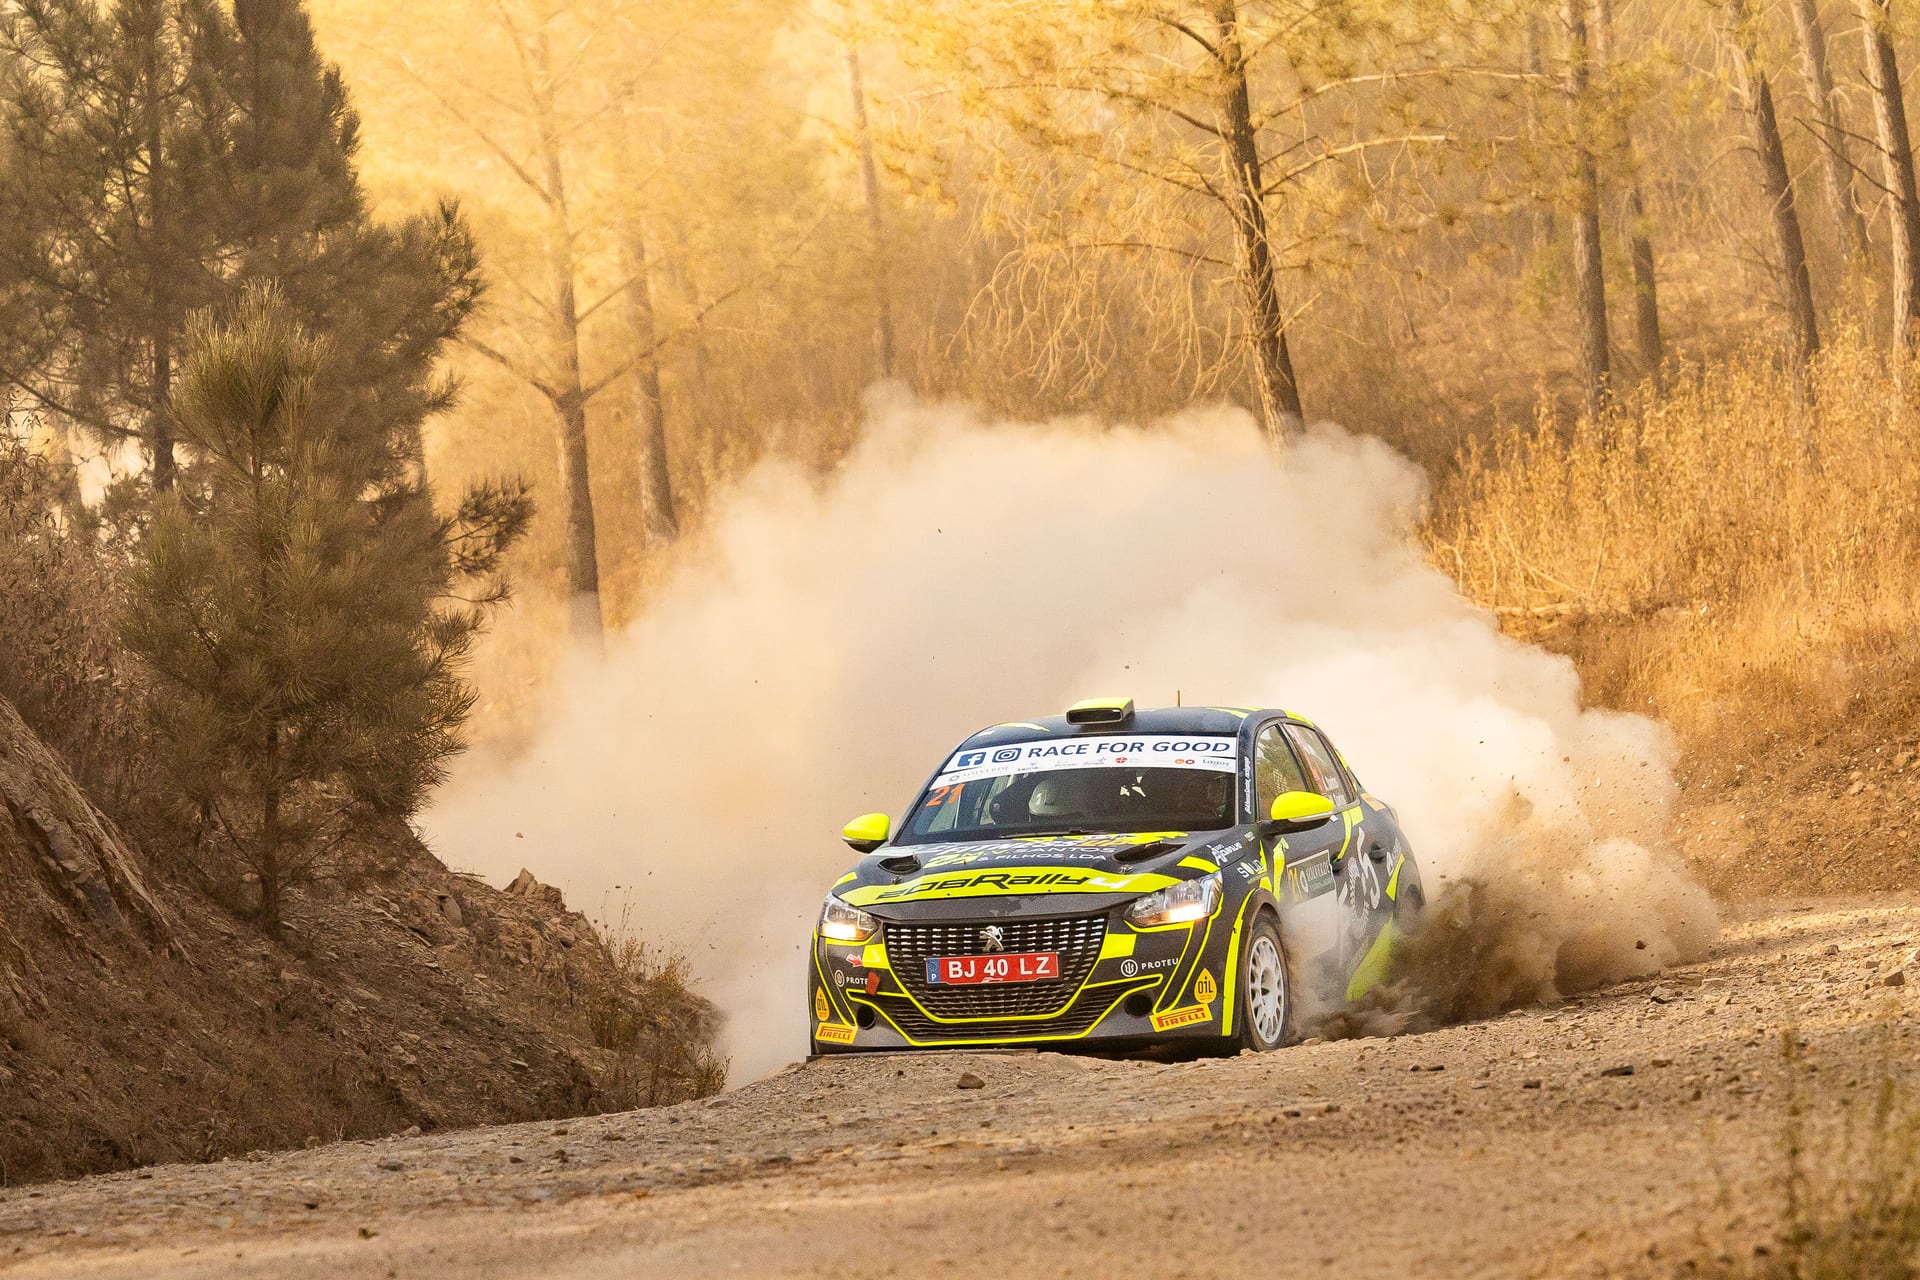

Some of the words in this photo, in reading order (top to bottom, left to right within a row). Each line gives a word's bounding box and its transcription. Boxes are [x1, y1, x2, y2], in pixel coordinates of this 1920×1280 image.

[1028, 744, 1090, 758] RACE
[1095, 742, 1145, 754] FOR
[1152, 741, 1231, 752] GOOD
[925, 783, 966, 807] 21
[1013, 846, 1118, 854] SANTOS
[931, 973, 937, 981] P
[947, 960, 976, 979] BJ
[983, 958, 1009, 976] 40
[1019, 956, 1051, 975] LZ
[1141, 958, 1179, 970] PROTEU
[1156, 1007, 1206, 1028] PIRELLI
[819, 1026, 853, 1041] PIRELLI
